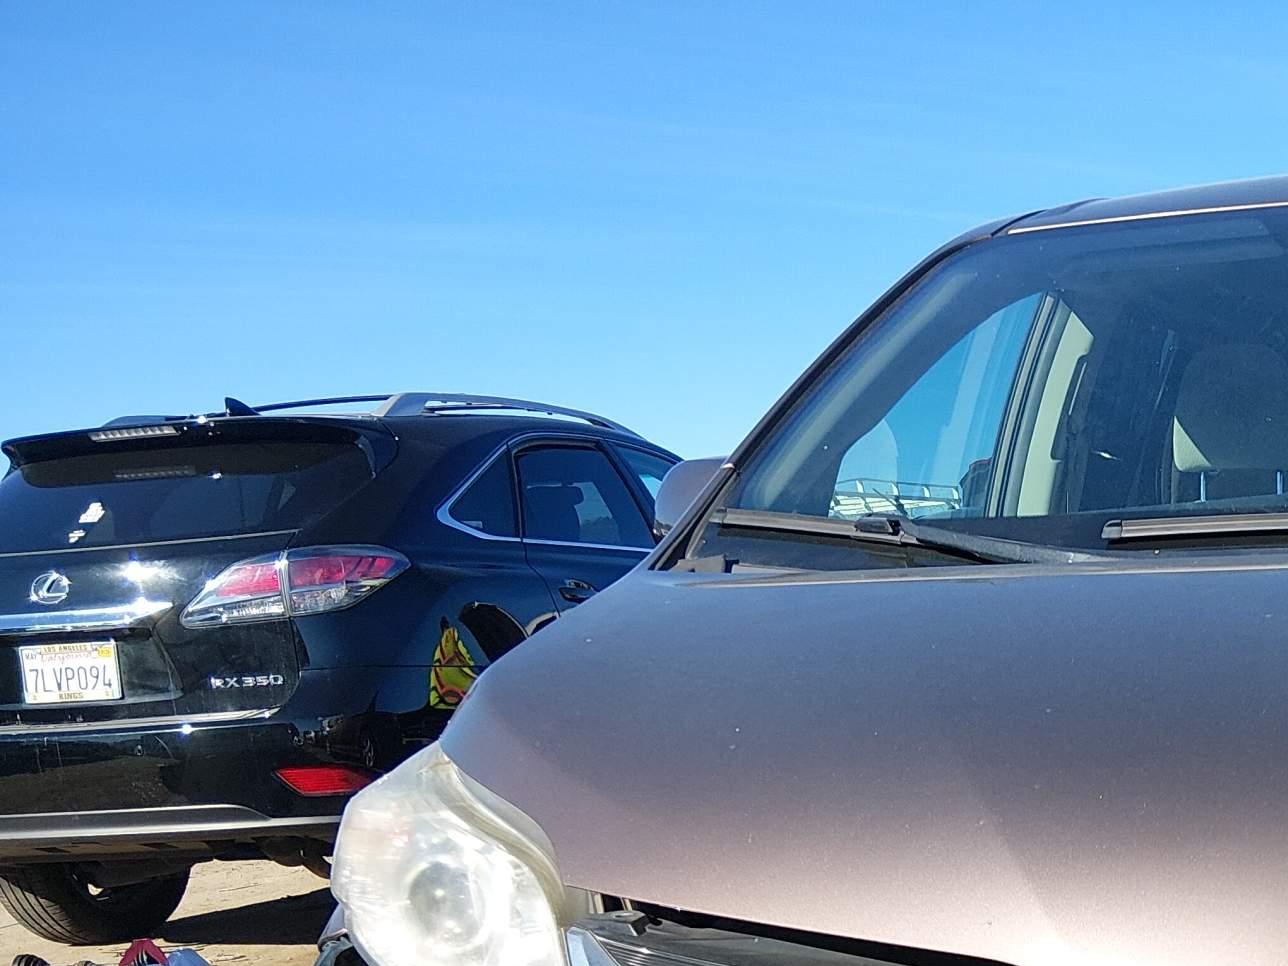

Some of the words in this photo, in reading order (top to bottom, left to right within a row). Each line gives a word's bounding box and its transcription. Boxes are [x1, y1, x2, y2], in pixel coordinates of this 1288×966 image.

[28, 664, 112, 693] 7LVP094
[210, 675, 240, 689] RX
[241, 673, 284, 688] 350
[58, 692, 85, 700] KINGS
